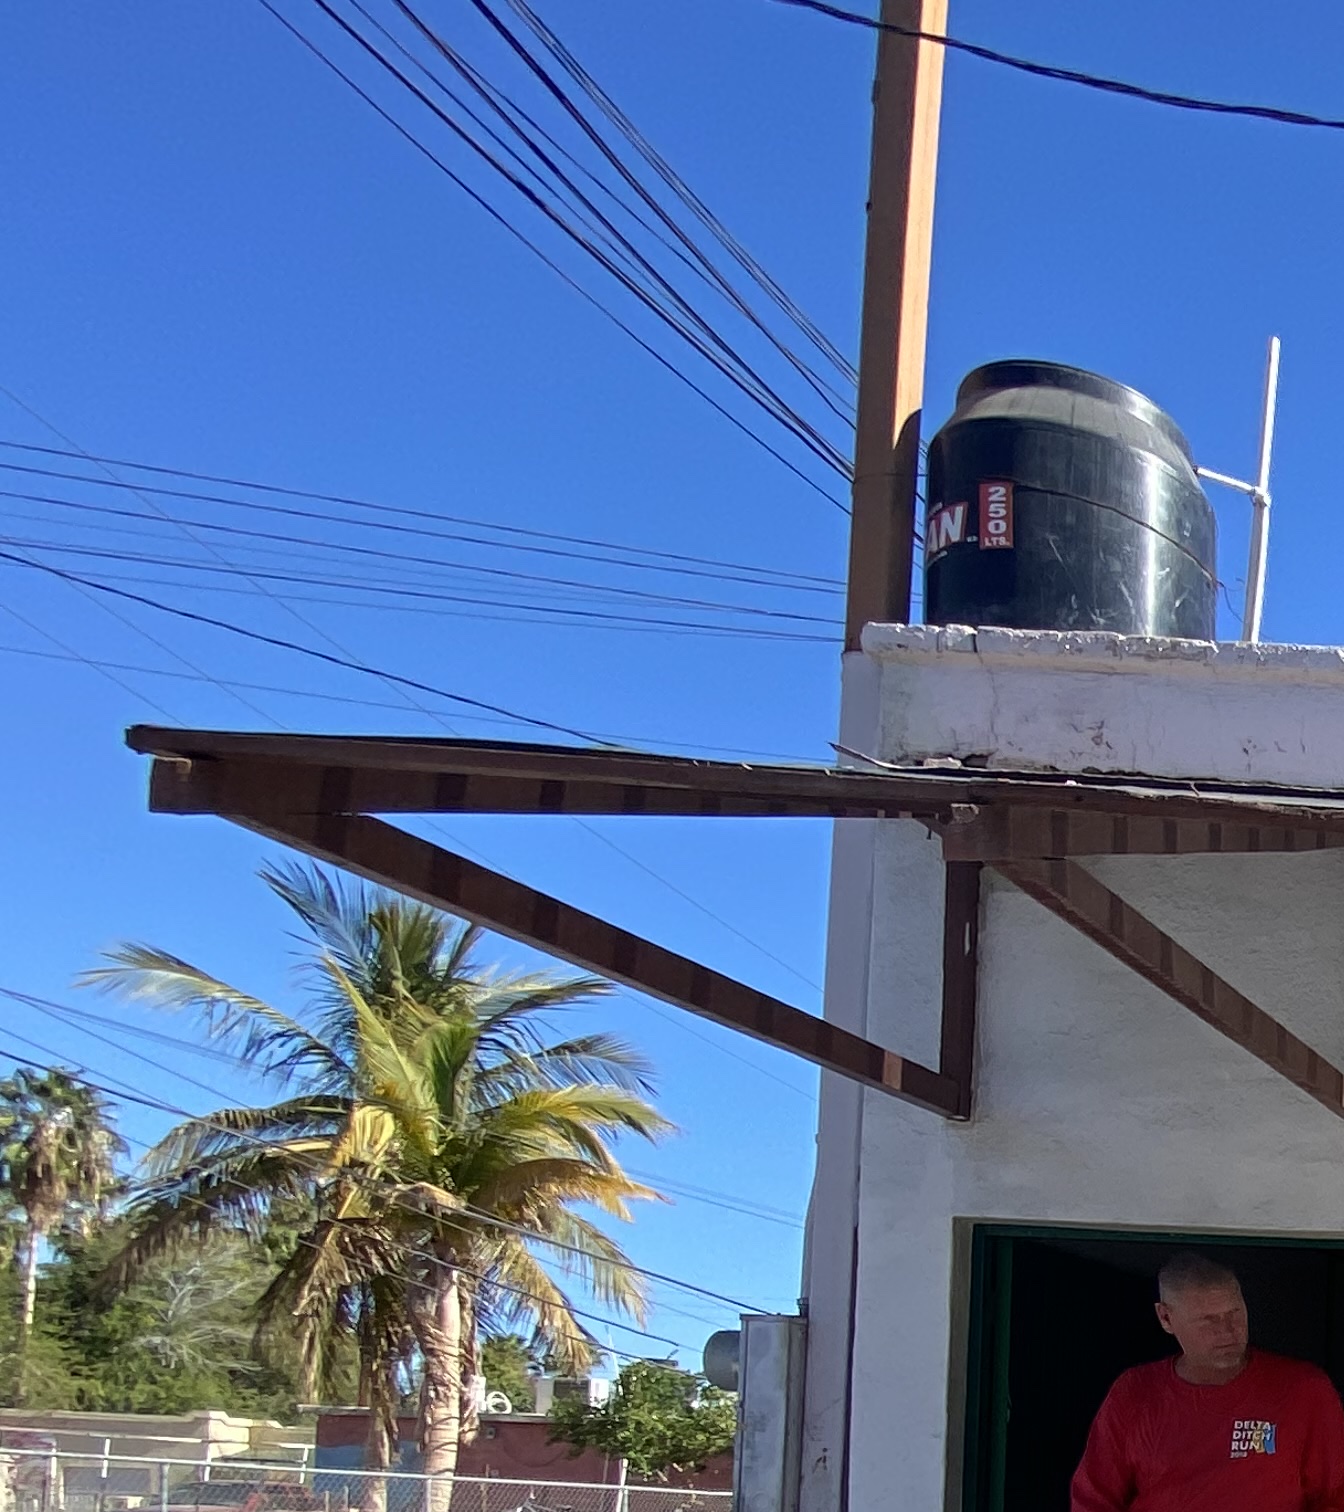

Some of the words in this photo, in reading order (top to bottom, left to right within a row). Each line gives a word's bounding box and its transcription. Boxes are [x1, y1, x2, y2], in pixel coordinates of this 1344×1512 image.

[1234, 1421, 1271, 1430] DELTA
[1233, 1430, 1271, 1440] DITCH
[1231, 1441, 1260, 1450] RUN
